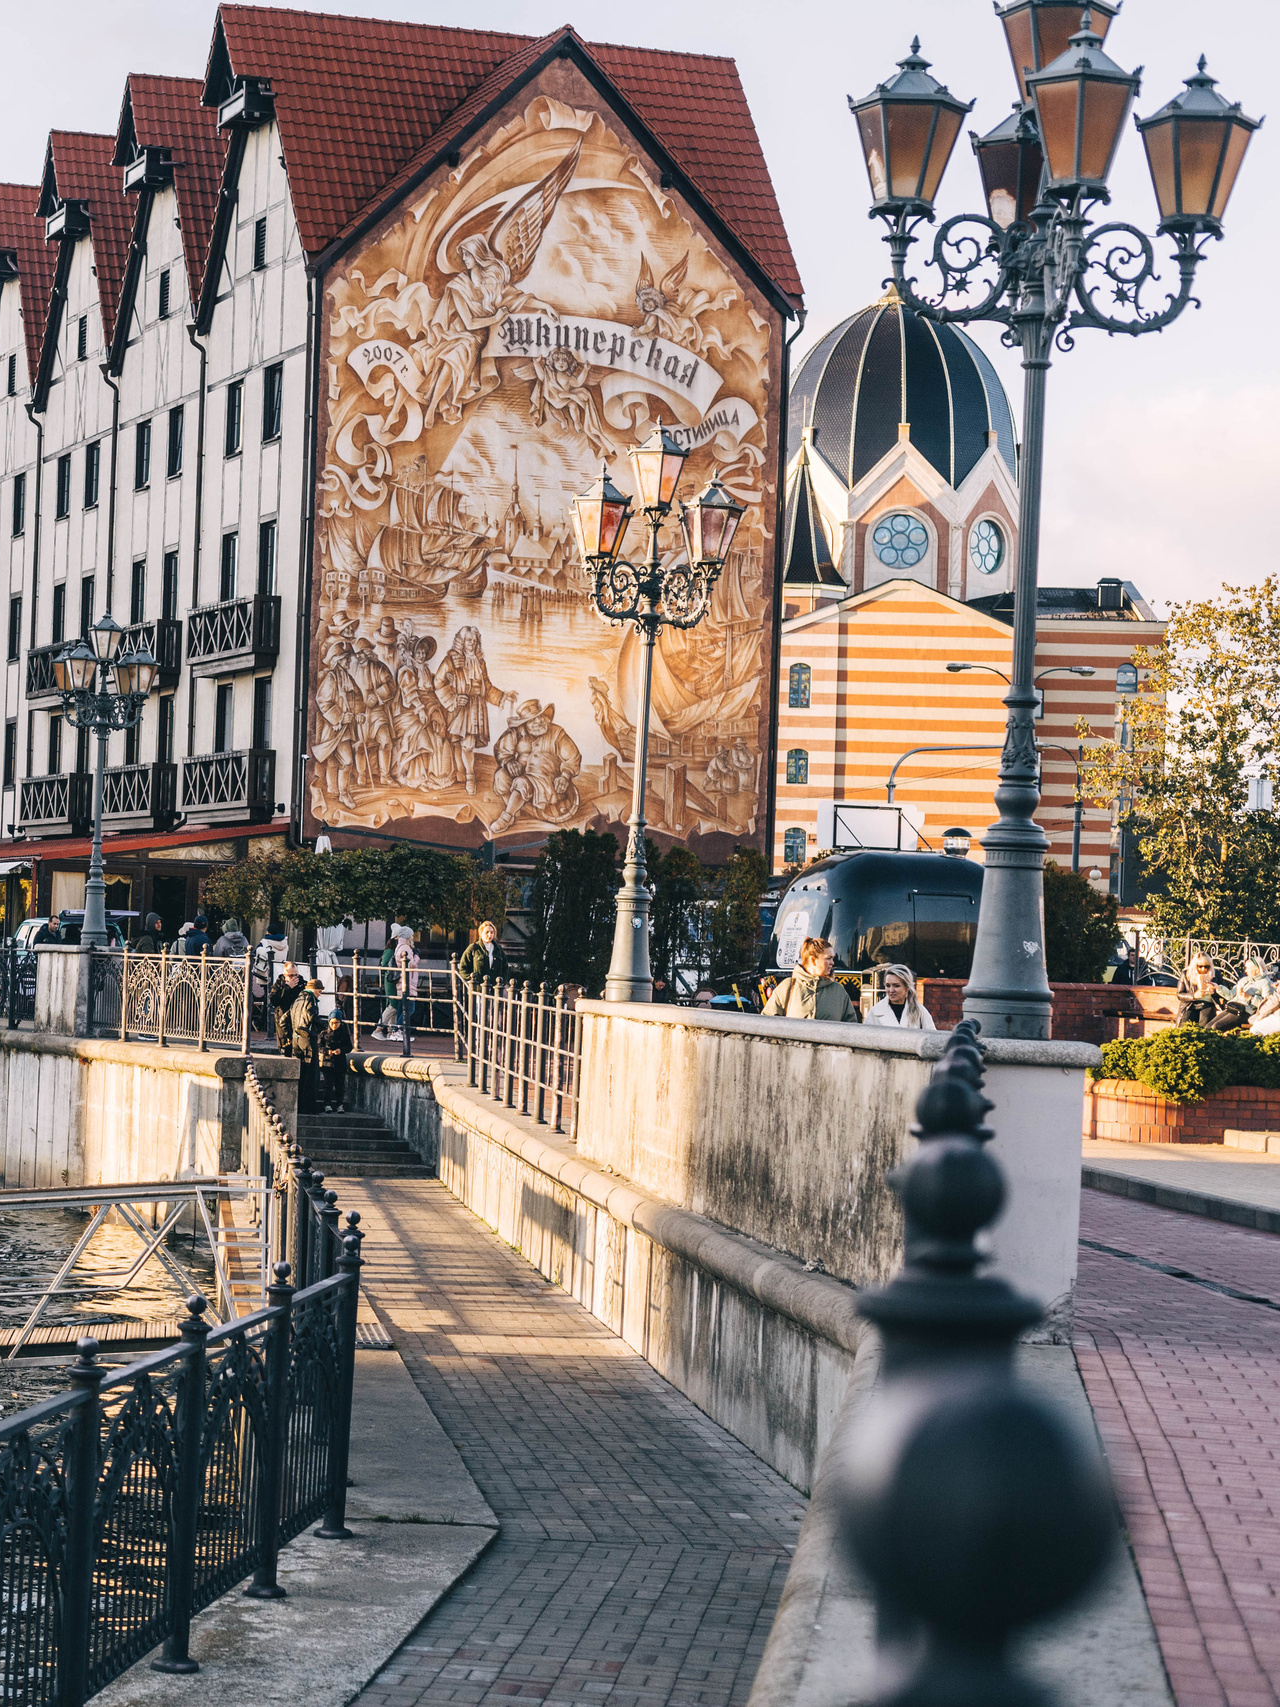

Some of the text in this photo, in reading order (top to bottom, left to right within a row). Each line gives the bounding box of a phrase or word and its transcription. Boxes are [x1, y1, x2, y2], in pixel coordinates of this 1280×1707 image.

[362, 345, 404, 365] 2007
[498, 315, 701, 389] Шкиперская
[665, 408, 740, 446] СТИНИЦА
